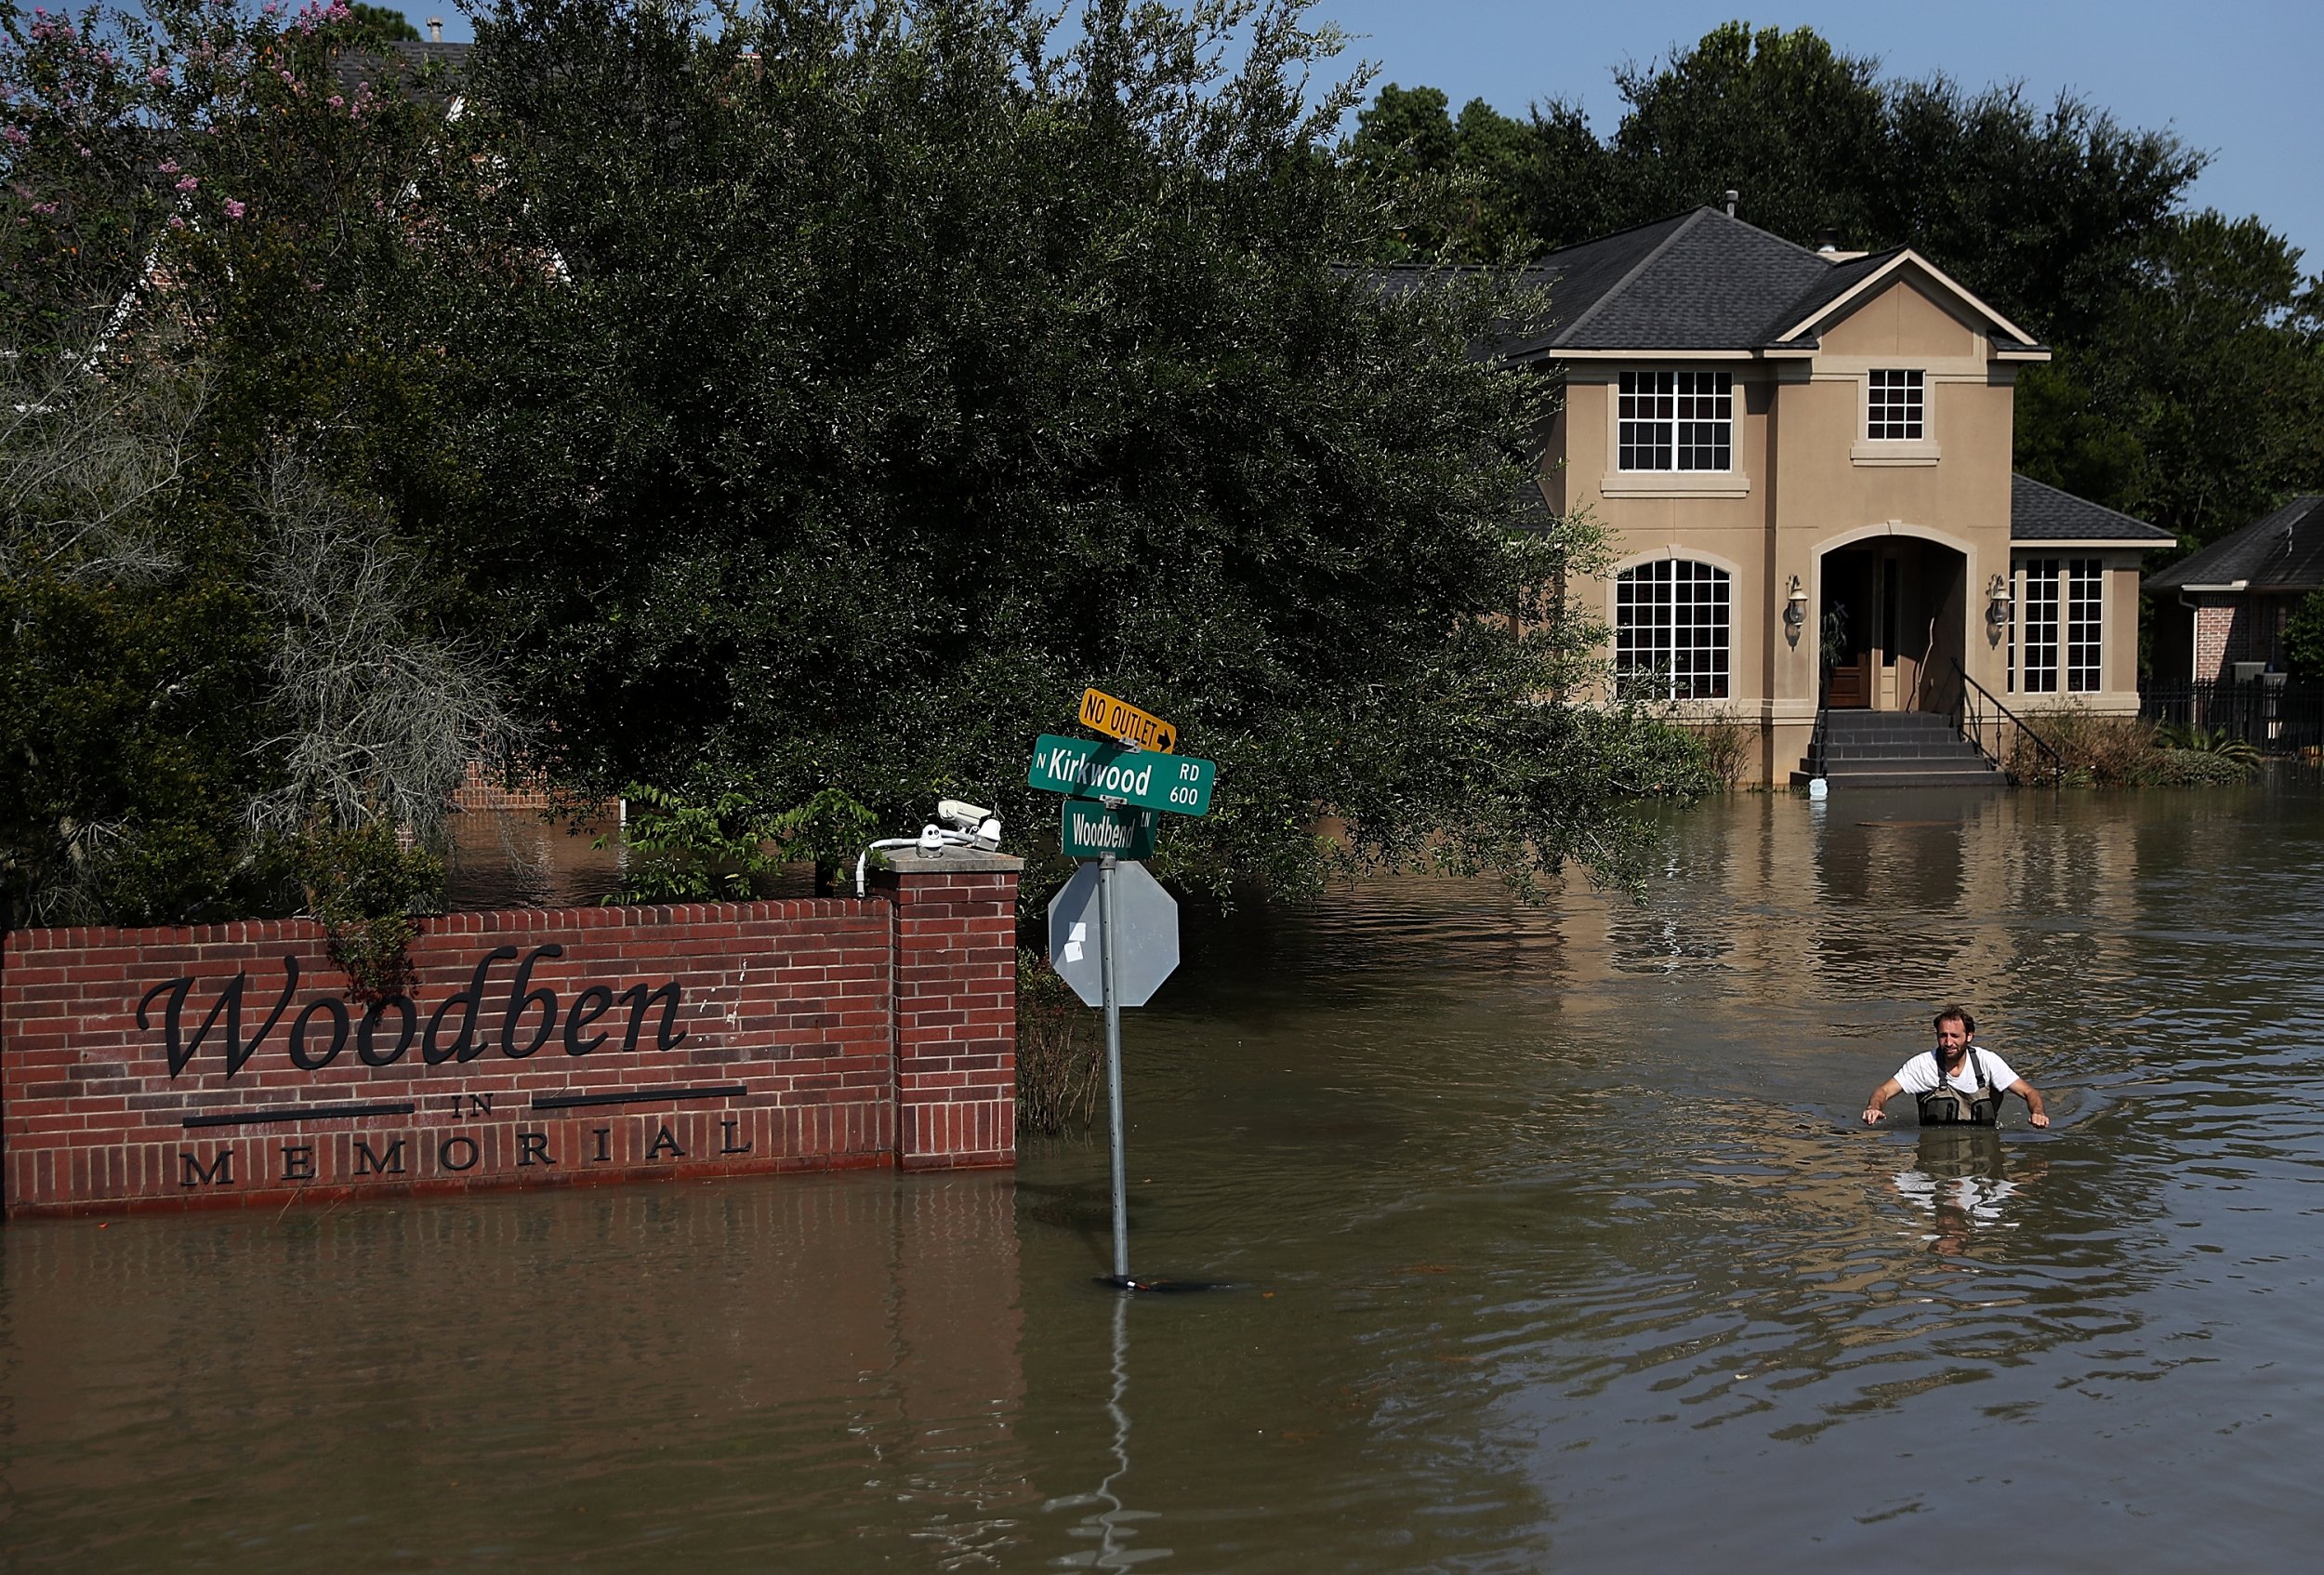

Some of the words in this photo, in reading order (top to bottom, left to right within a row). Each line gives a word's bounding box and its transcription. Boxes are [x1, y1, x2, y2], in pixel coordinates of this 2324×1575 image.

[1084, 694, 1106, 724] NO
[1110, 705, 1157, 748] OUTLET
[1036, 753, 1047, 770] N
[1048, 748, 1152, 796] Kirkwood
[1179, 763, 1200, 782] RD
[1169, 787, 1198, 806] 600
[1073, 813, 1135, 848] Woodbend
[1141, 812, 1152, 828] LN
[137, 944, 687, 1080] Woodben
[451, 1092, 494, 1118] IN
[179, 1120, 752, 1186] MEMORIAL
